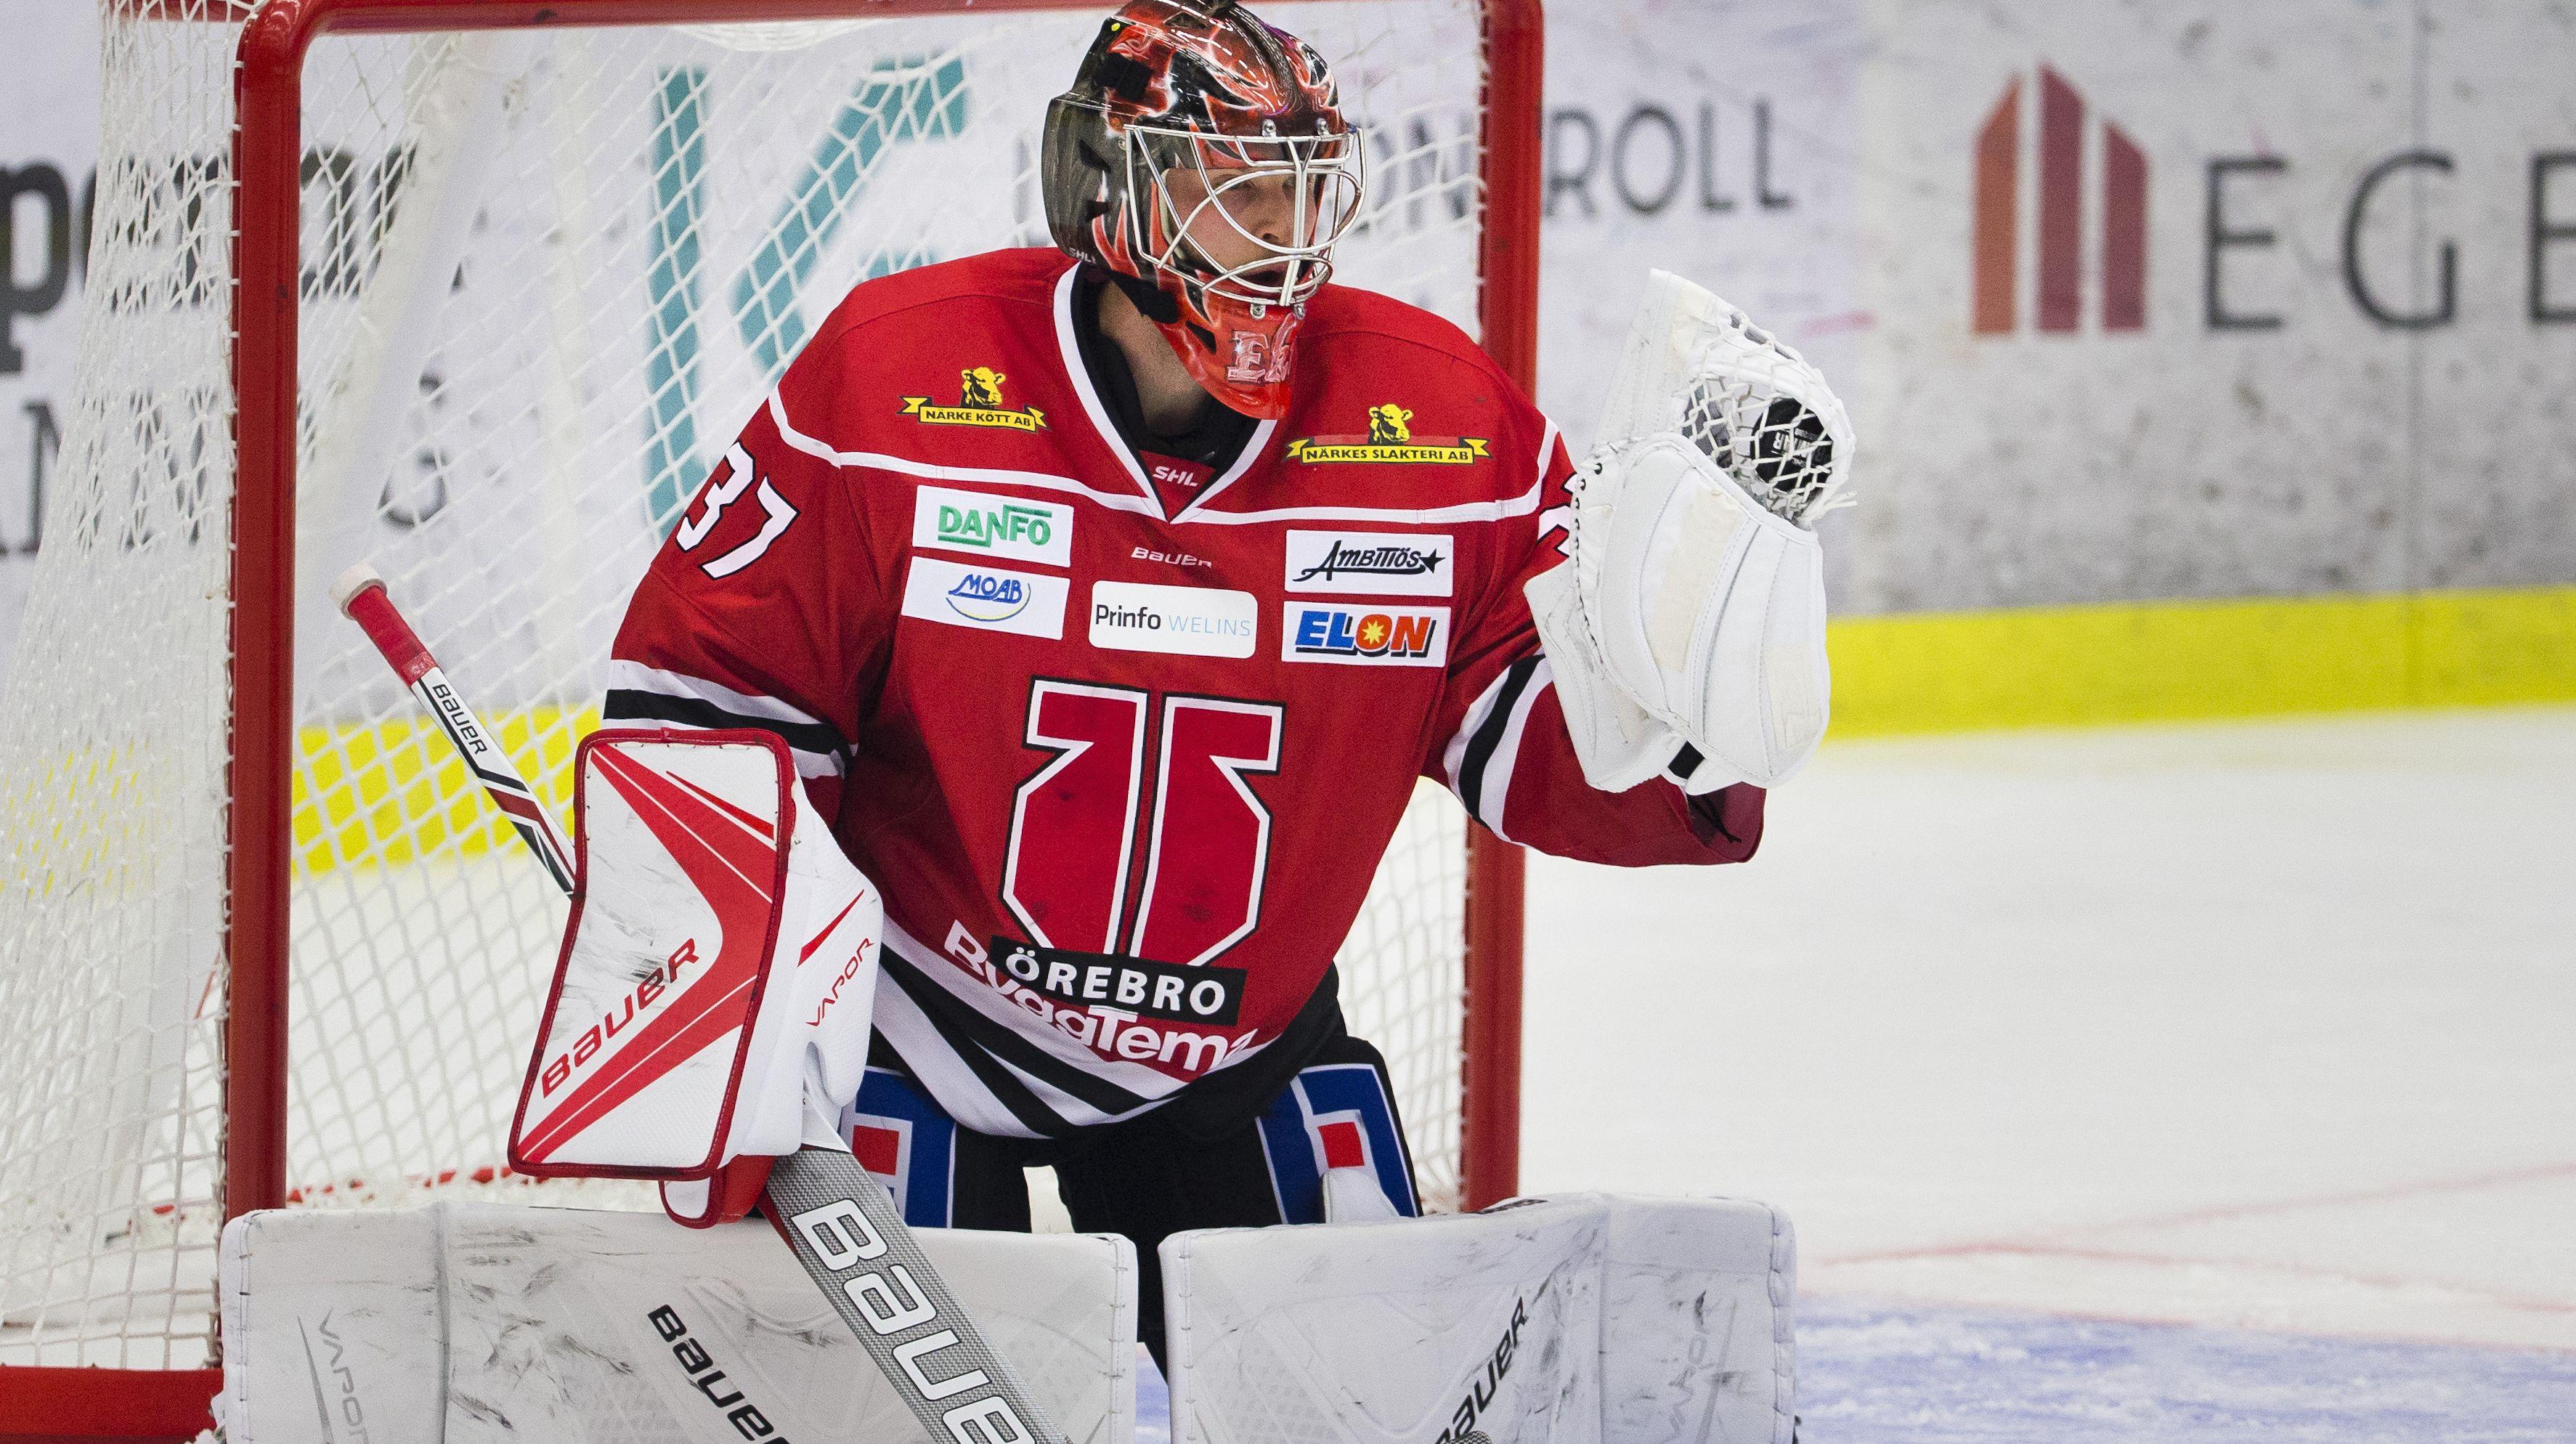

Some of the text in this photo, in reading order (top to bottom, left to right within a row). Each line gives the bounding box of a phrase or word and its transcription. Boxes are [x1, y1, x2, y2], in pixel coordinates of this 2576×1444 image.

[925, 409, 1031, 426] NÄRKE KÖTT AB
[1307, 448, 1468, 461] NÄRKES SLAKTERI AB
[1152, 466, 1198, 487] SHL
[674, 439, 801, 580] 37
[938, 504, 1052, 548] DANFO
[948, 574, 1023, 604] MOAB
[1095, 604, 1251, 636] Prinfo WELINS
[1295, 610, 1437, 657] ELON
[805, 938, 874, 1026] VAPOR
[1006, 946, 1225, 1015] ÖREBRO
